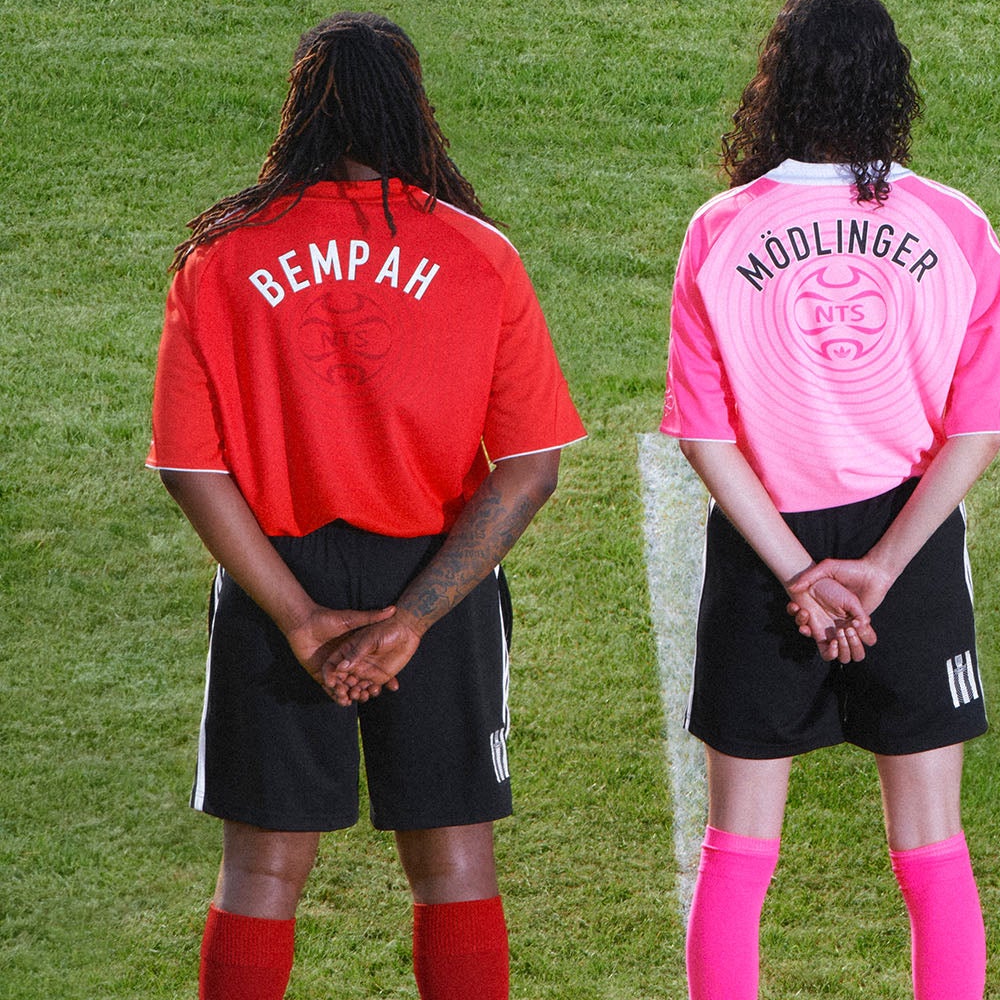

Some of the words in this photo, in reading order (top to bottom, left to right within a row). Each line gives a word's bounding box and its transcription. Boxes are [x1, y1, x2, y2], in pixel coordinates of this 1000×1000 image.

[248, 239, 440, 308] BEMPAH
[736, 219, 939, 292] MÖDLINGER
[815, 305, 865, 323] NTS
[322, 329, 368, 349] NTS
